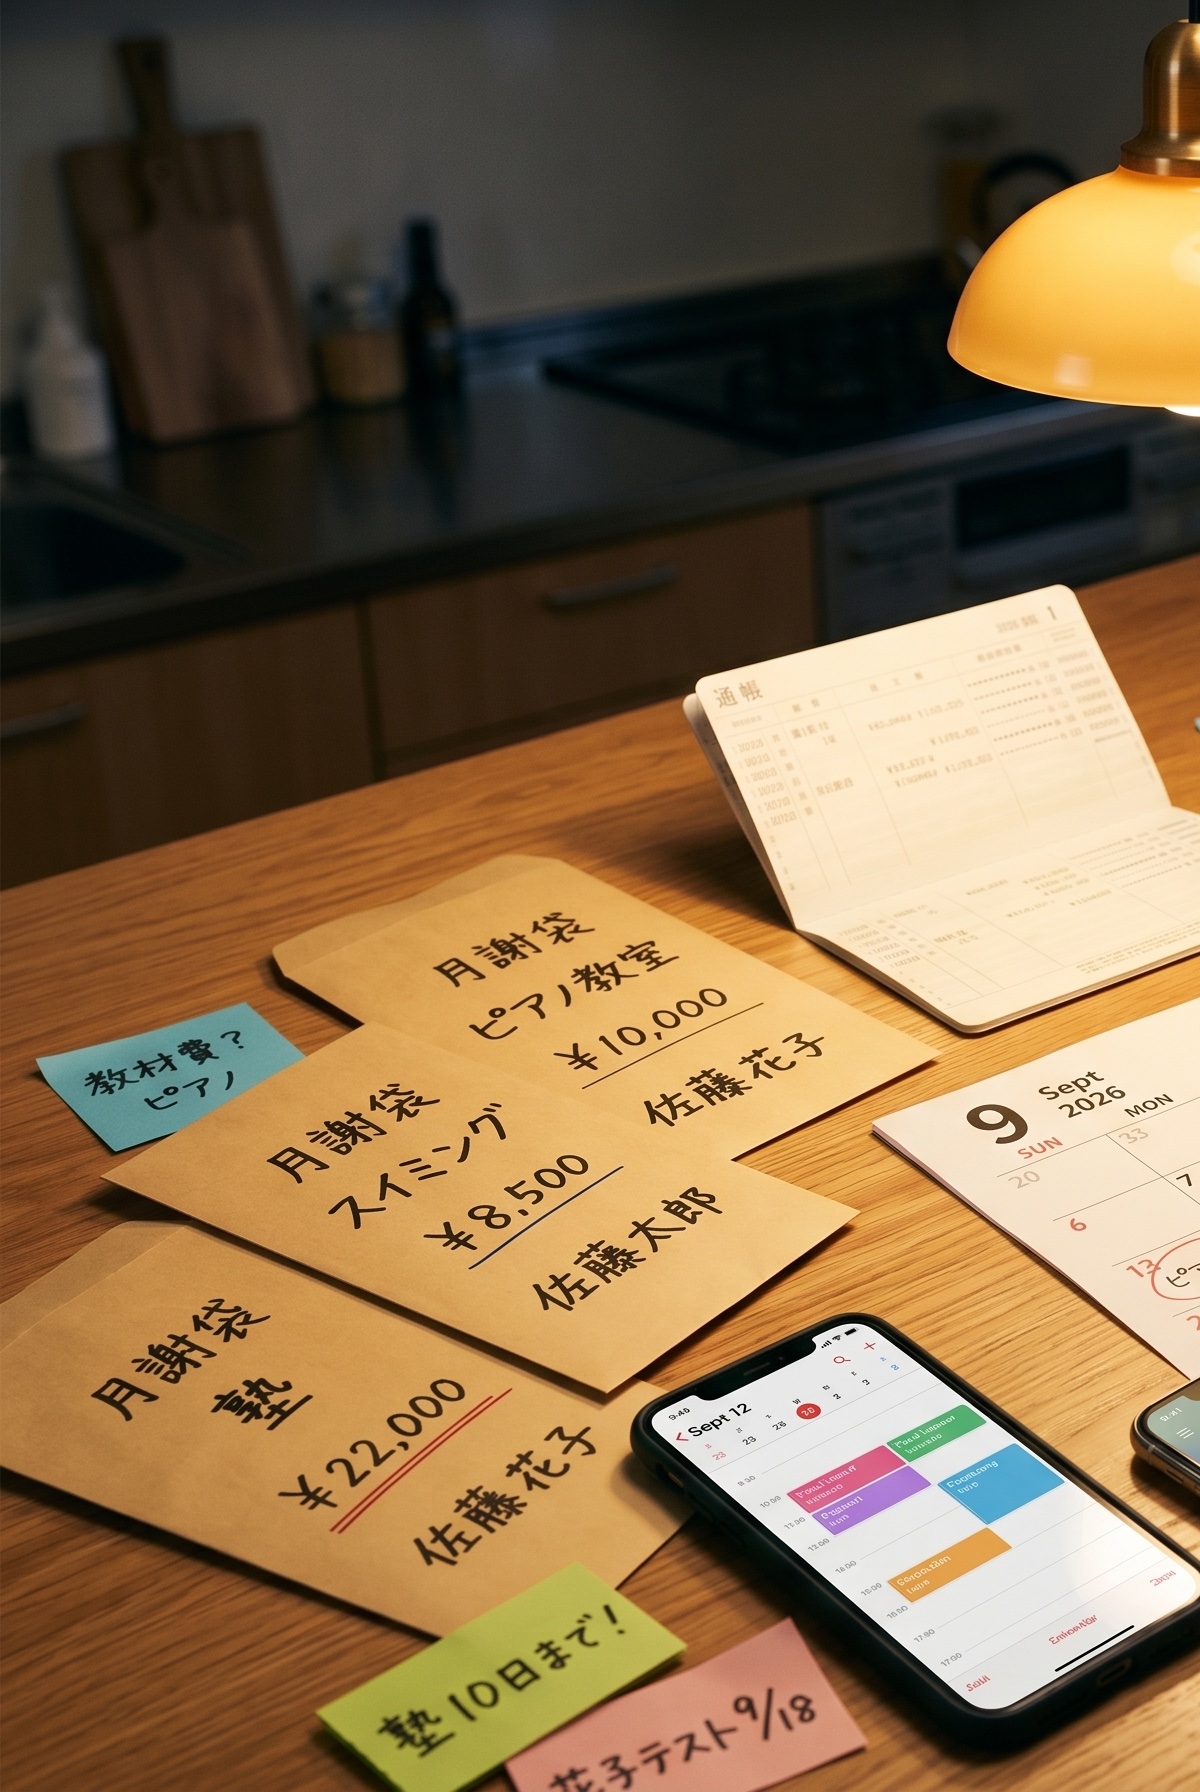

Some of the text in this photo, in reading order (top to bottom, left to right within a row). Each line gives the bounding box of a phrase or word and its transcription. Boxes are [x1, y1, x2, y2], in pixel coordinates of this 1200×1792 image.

[713, 680, 764, 709] 通帳
[433, 912, 595, 988] 月謝袋
[469, 940, 680, 1041] ピアノ教室
[554, 988, 728, 1072] ¥10,000
[84, 1030, 245, 1097] 教材費?
[644, 1032, 825, 1128] 佐藤花子
[1038, 1070, 1105, 1101] Sept
[144, 1070, 235, 1111] ピアノ
[1058, 1085, 1126, 1118] 2026
[1124, 1093, 1174, 1118] MON
[266, 1083, 441, 1184] 月謝袋
[966, 1104, 1029, 1144] 9
[1017, 1136, 1064, 1160] SUN
[1118, 1127, 1149, 1144] 33
[328, 1103, 508, 1230] スイミング
[1007, 1171, 1041, 1189] 20
[1176, 1173, 1193, 1188] 7
[423, 1154, 589, 1252] ¥8,500
[1069, 1218, 1087, 1232] 6
[532, 1186, 723, 1312] 佐藤太郎
[1126, 1258, 1162, 1278] 13
[90, 1298, 271, 1422] 月謝袋
[211, 1376, 314, 1431] 塾
[688, 1403, 752, 1438] Sept 12
[278, 1378, 466, 1511] ¥22,000
[413, 1426, 598, 1568] 佐藤花子
